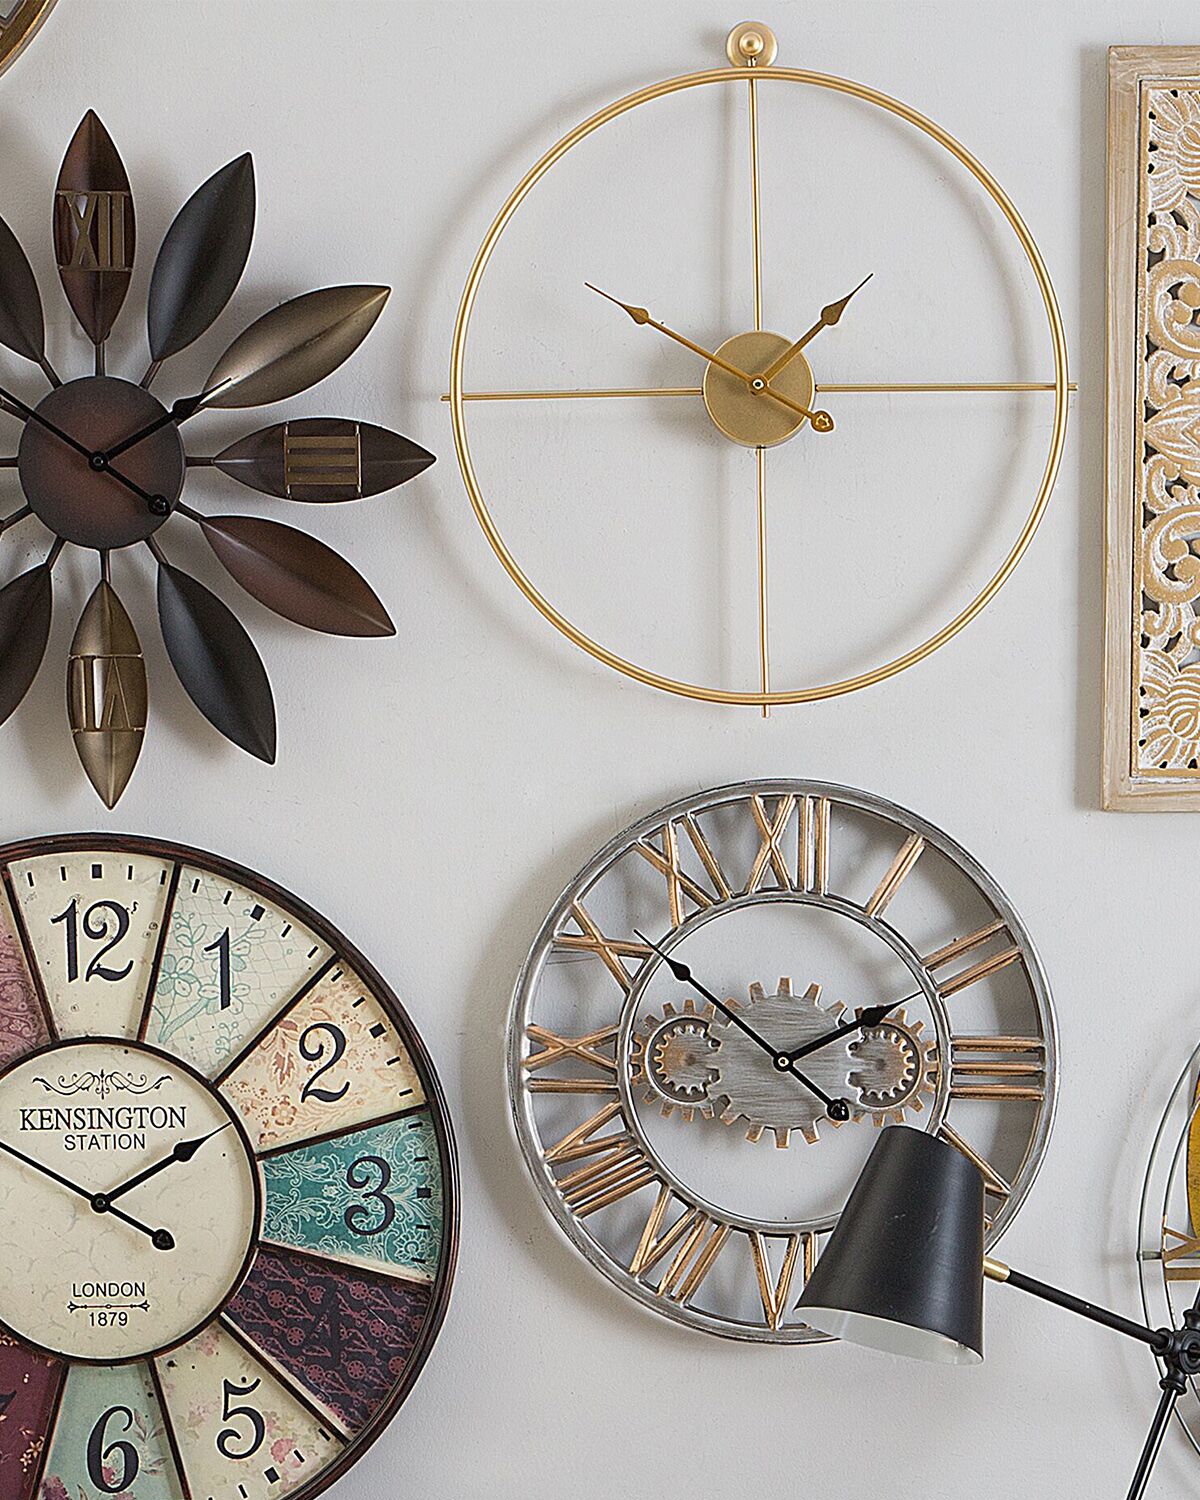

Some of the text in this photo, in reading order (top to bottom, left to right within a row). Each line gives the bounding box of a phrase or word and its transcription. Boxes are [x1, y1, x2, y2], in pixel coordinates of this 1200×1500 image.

[56, 191, 134, 271] XII
[285, 421, 362, 499] III
[636, 813, 732, 928] XI
[746, 793, 832, 896] XII
[50, 900, 135, 983] 12
[204, 926, 233, 1012] 1
[552, 900, 654, 996] X
[298, 1022, 352, 1103] 2
[523, 1023, 620, 1094] IX
[951, 1035, 1045, 1102] III
[18, 1105, 188, 1131] KENSINGTON
[64, 1133, 146, 1152] STATION
[346, 1157, 396, 1237] 3
[629, 1184, 733, 1306] VII
[71, 1282, 147, 1298] LONDON
[88, 1311, 129, 1327] 1879
[86, 1406, 141, 1494] 6
[216, 1377, 266, 1460] 5
